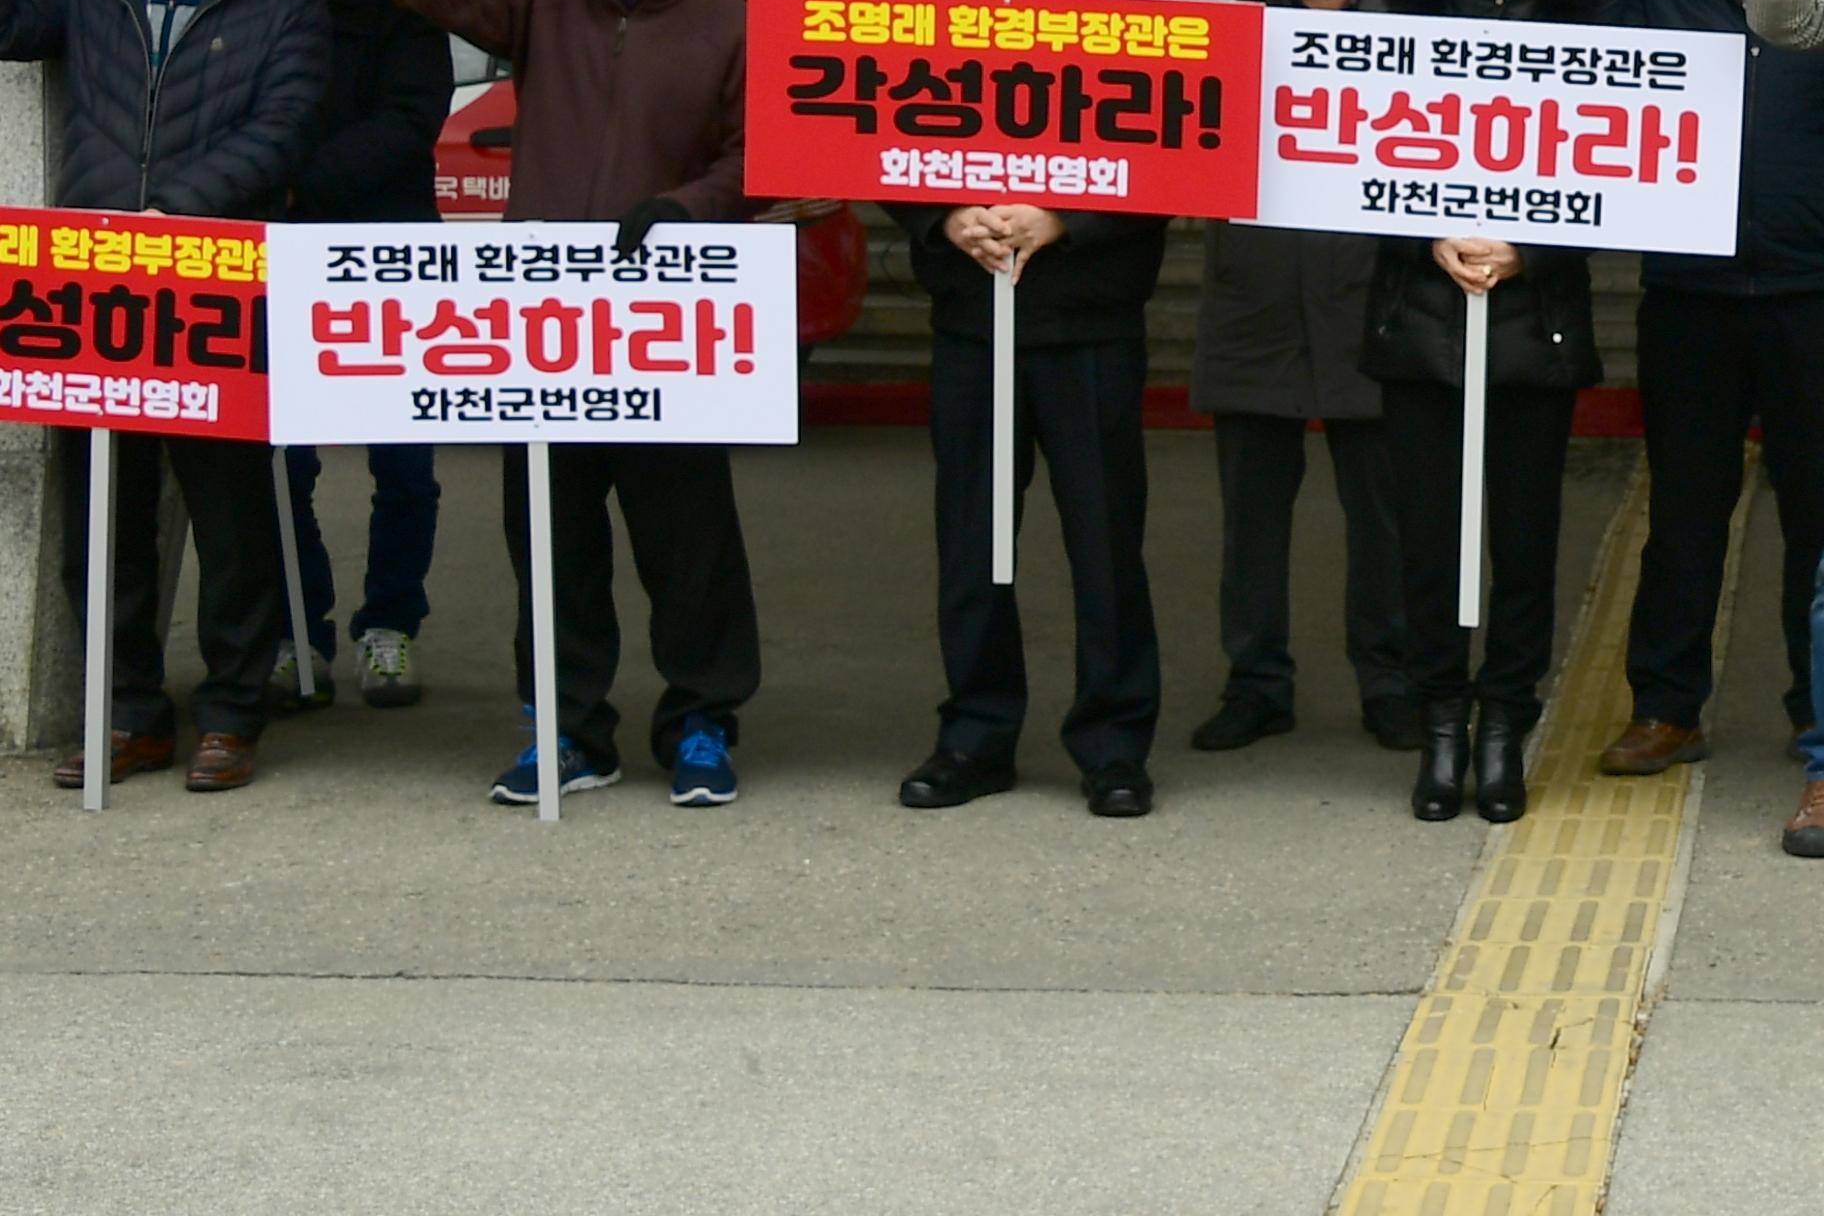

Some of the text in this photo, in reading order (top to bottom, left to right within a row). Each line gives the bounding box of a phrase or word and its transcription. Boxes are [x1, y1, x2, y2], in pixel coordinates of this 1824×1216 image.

[802, 0, 1211, 60] 조명래 환경부장관은
[1291, 30, 1689, 91] 조명래 환경부장관은
[786, 55, 1223, 151] 각성하라!
[1274, 84, 1700, 185] 반성하라!
[879, 147, 1130, 198] 화천군번영회
[1360, 177, 1603, 227] 화천군번영회
[326, 244, 739, 284] 조명래 환경부장관은
[311, 297, 756, 377] 반성하라!
[411, 387, 662, 422] 화천군번영회
